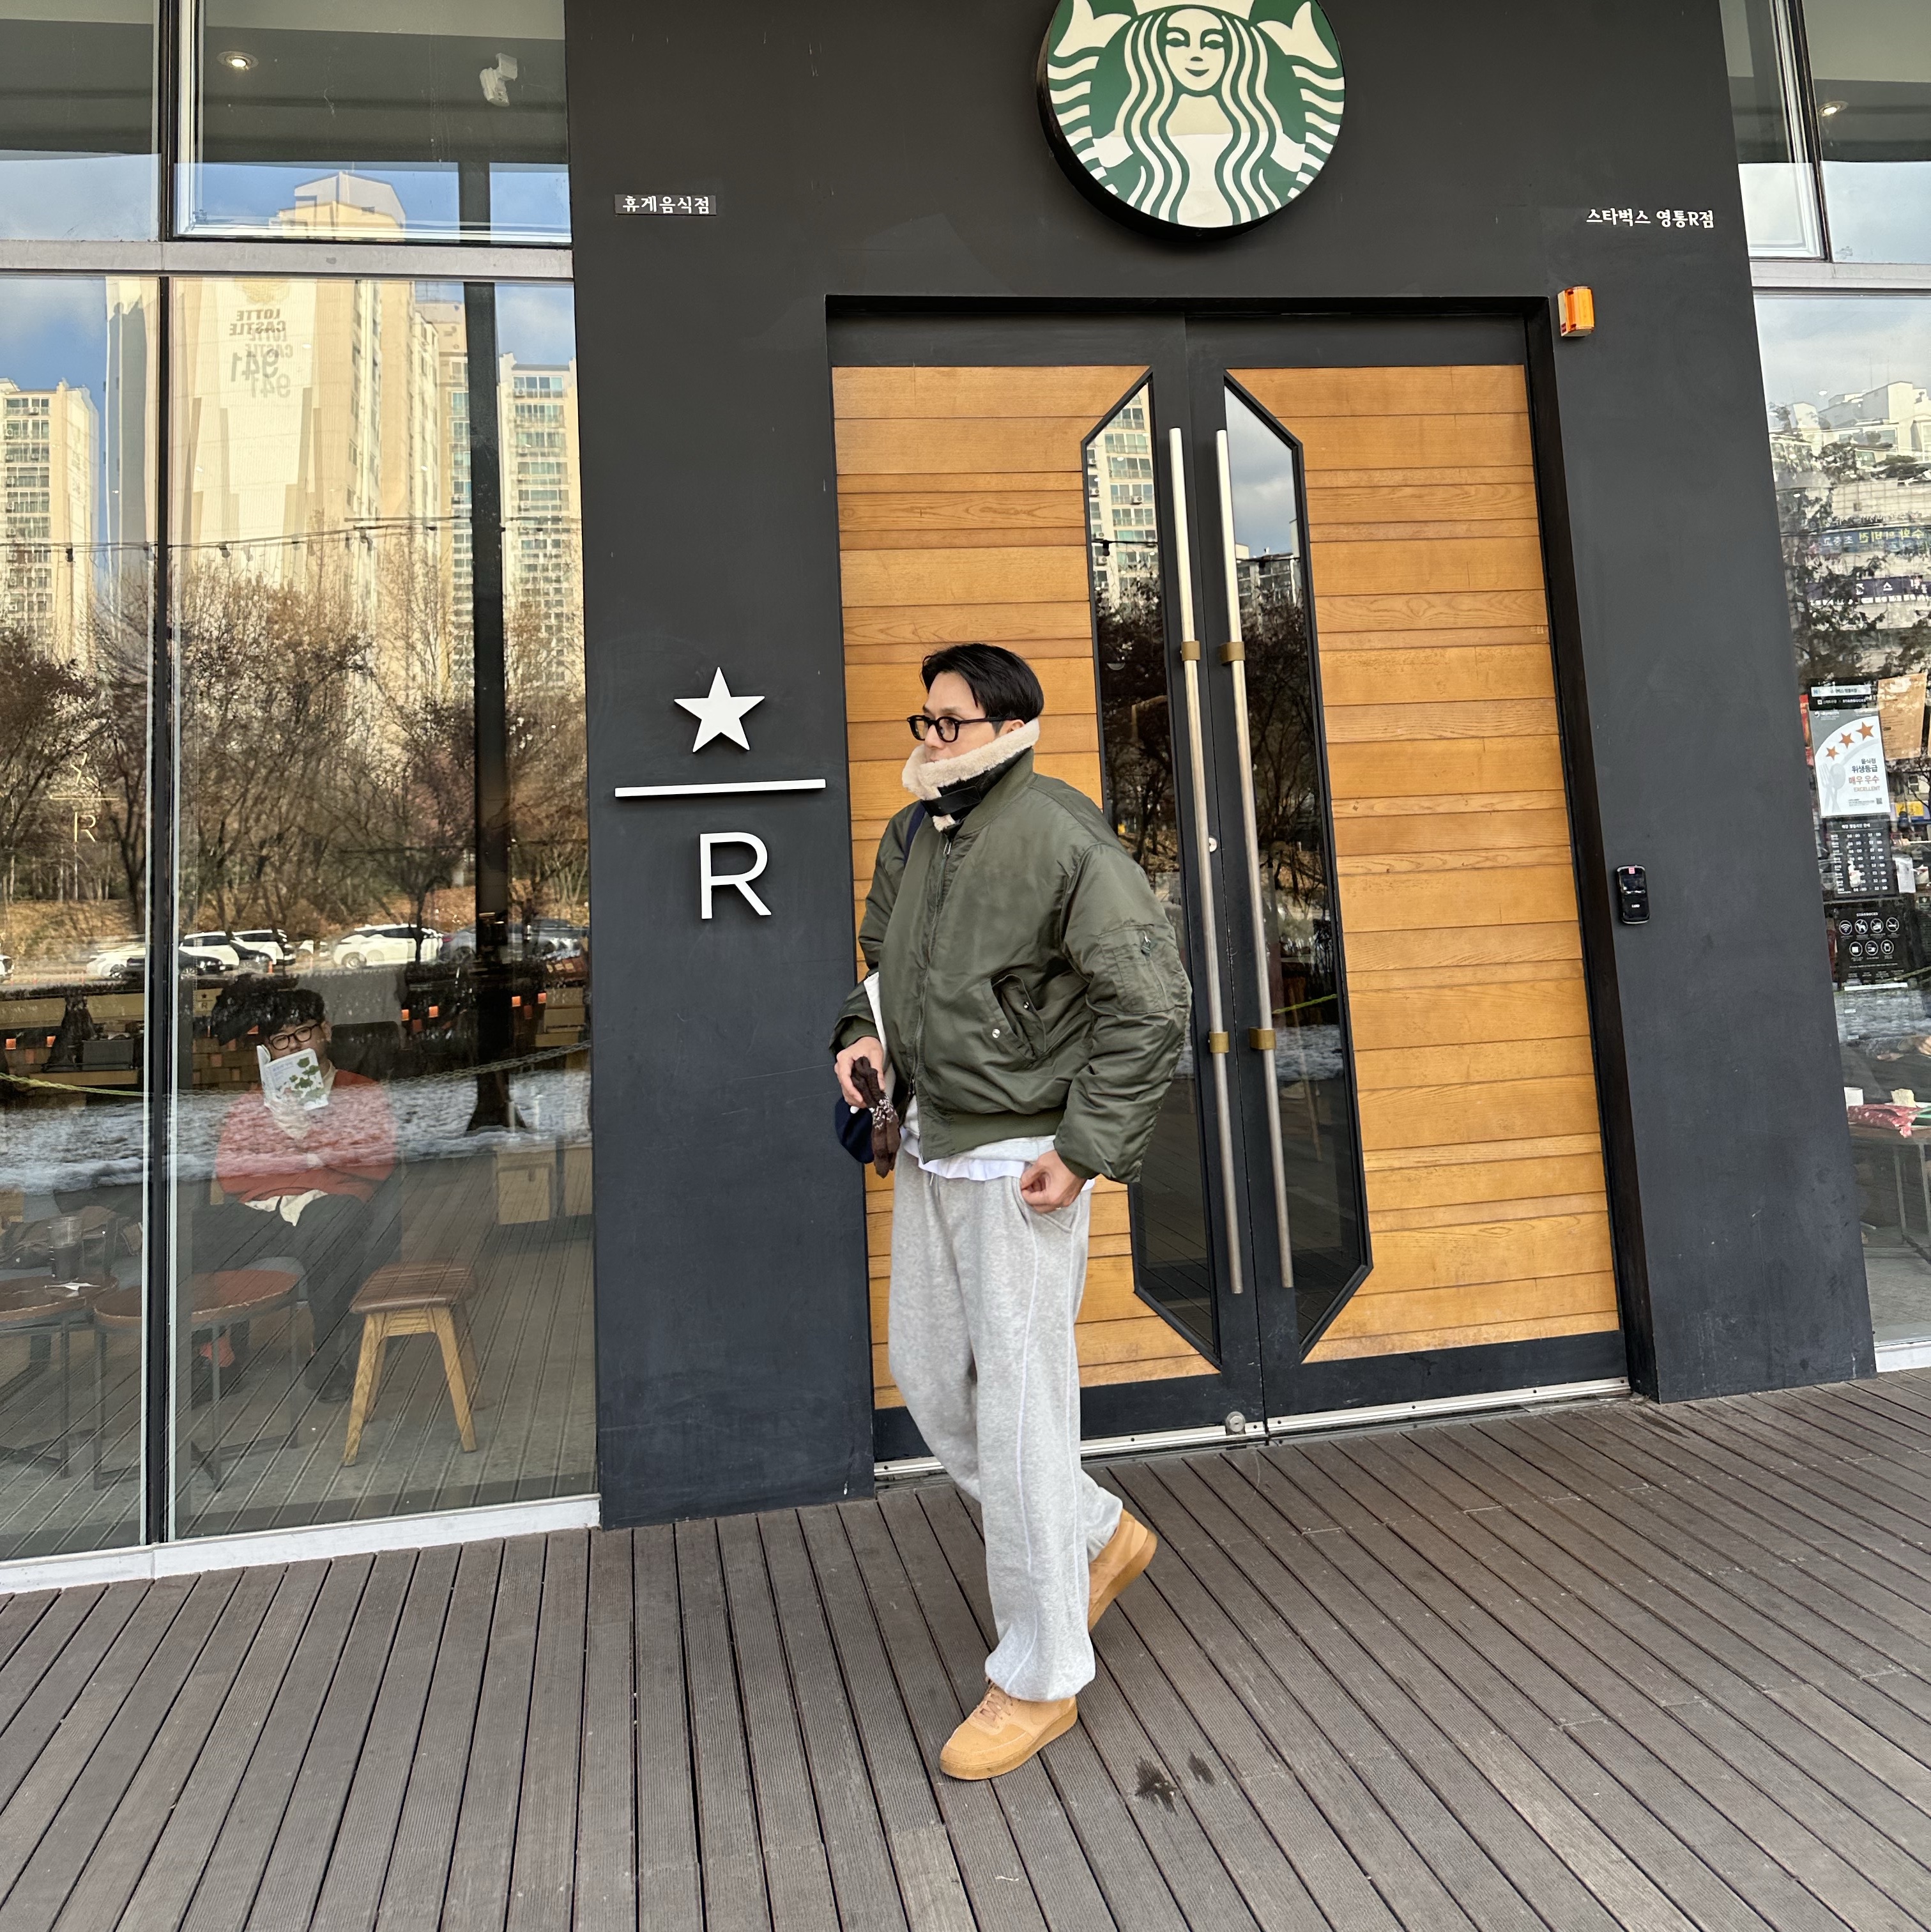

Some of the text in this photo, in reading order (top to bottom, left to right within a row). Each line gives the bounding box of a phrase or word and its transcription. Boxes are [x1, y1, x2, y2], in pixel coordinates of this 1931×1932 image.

[622, 195, 710, 215] 휴게음식점
[1586, 208, 1714, 229] 스타벅스 영통R점
[1852, 765, 1878, 774] 위생등급
[1849, 775, 1880, 785] 매우 우수
[700, 832, 772, 919] R
